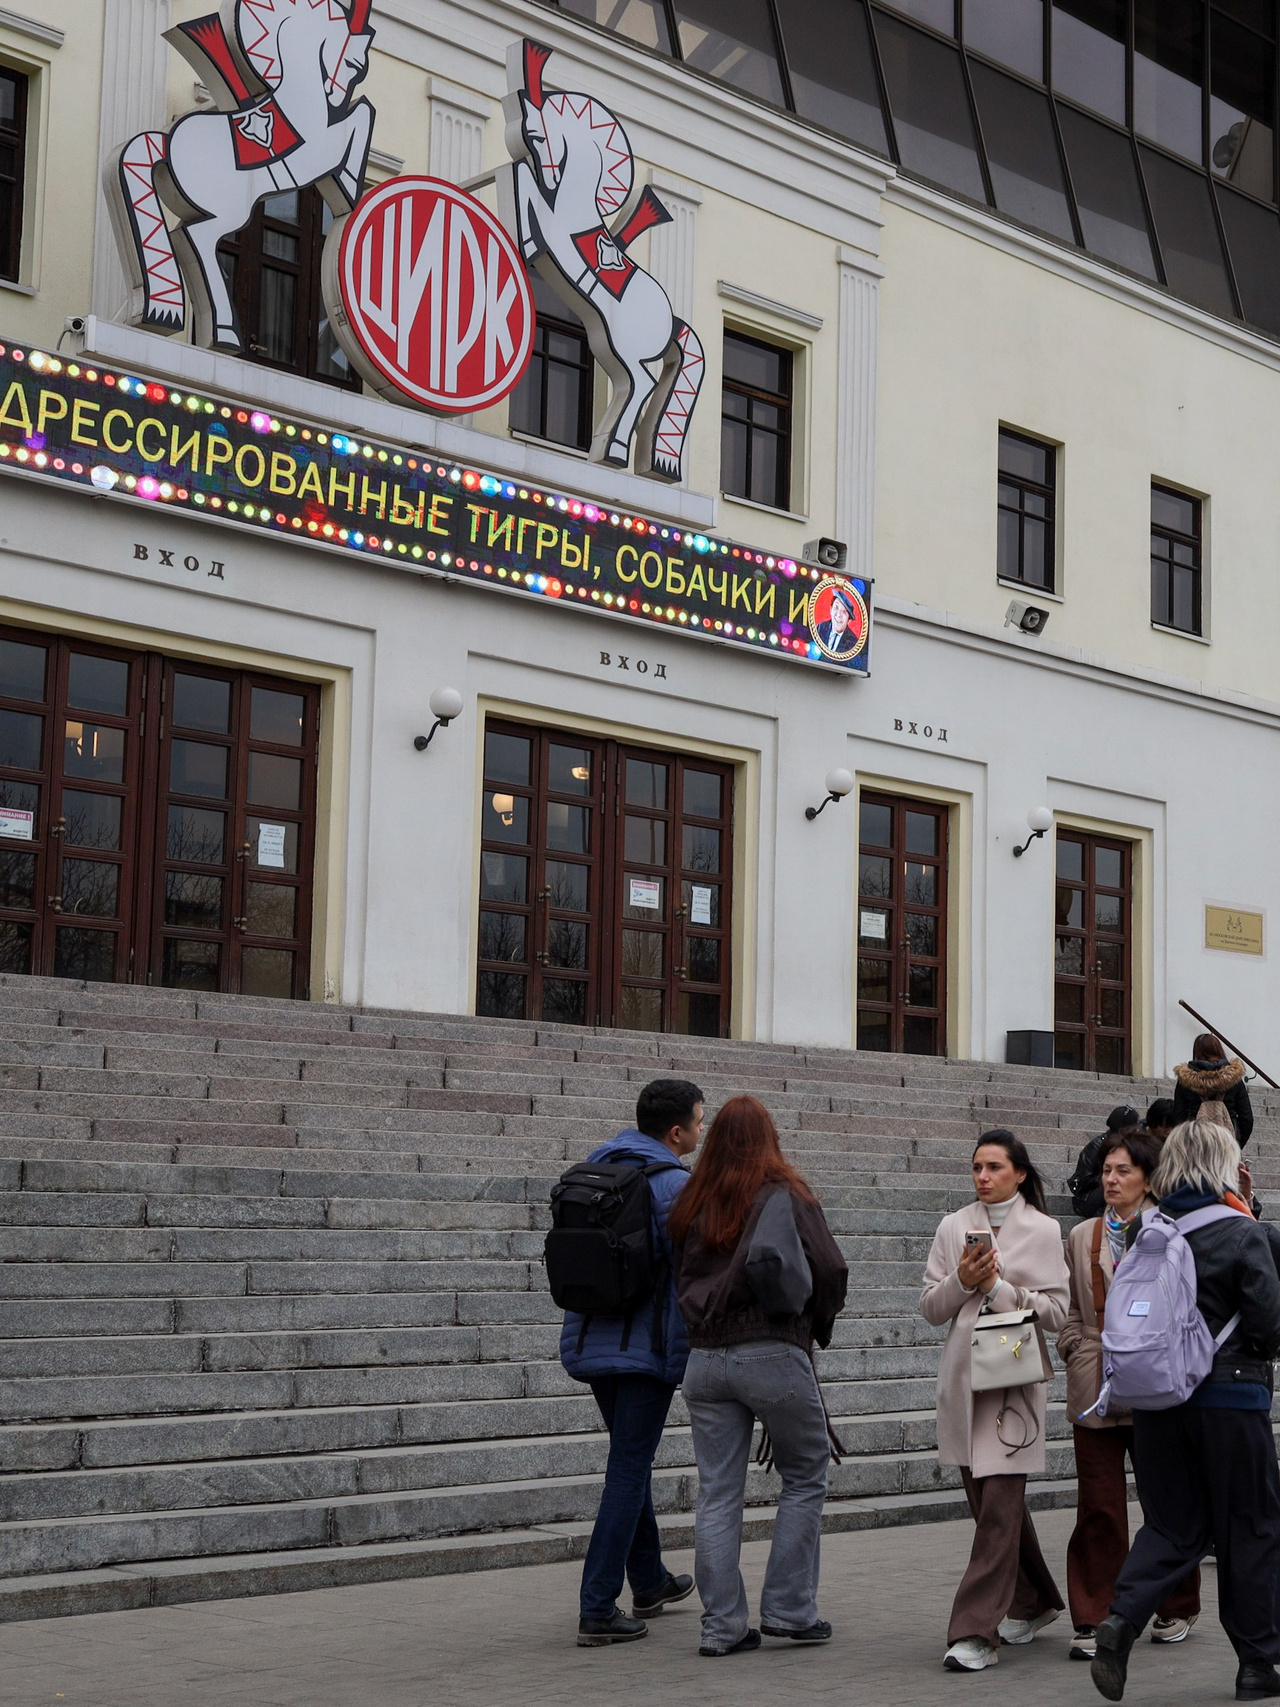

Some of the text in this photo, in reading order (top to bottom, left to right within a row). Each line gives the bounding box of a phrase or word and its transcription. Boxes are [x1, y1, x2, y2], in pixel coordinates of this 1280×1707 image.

[360, 196, 518, 394] ЦИРК
[0, 381, 809, 626] ДРЕССИРОВАННЫЕ ТИГРЫ, СОБАЧКИ И
[133, 543, 225, 580] ВХОД
[600, 651, 667, 680] ВХОД
[893, 718, 948, 743] ВХОД
